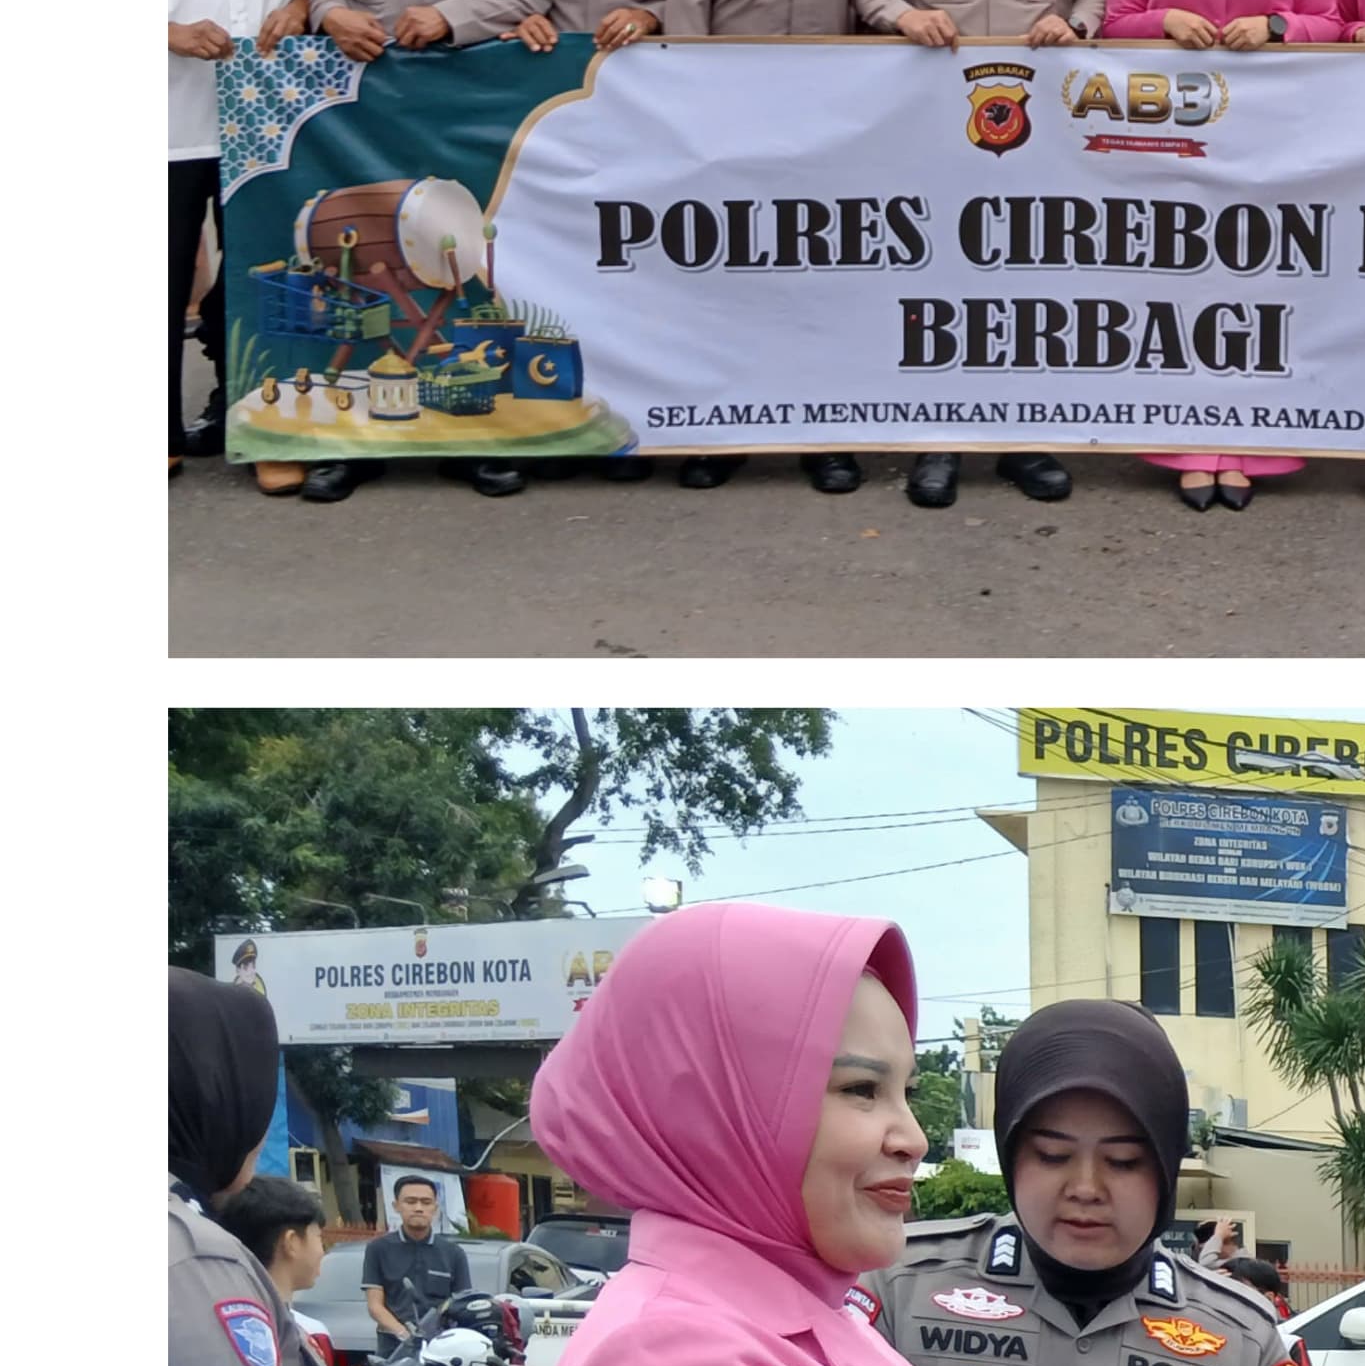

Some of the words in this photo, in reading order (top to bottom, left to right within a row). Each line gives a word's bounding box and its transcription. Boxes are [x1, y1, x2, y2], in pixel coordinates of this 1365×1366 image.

[969, 68, 995, 79] JAWA
[1072, 72, 1212, 126] AB3
[596, 196, 930, 272] POLRES
[957, 198, 1330, 275] CIREBON
[899, 297, 1290, 373] BERBAGI
[647, 405, 795, 427] SELAMAT
[802, 402, 1009, 423] MENUNAIKAN
[1016, 403, 1136, 424] IBADAH
[1142, 405, 1244, 427] PUASA
[1034, 719, 1208, 770] POLRES
[1151, 799, 1206, 818] POLRES
[1208, 803, 1270, 822] CIREBON
[1271, 809, 1309, 825] KOTA
[315, 964, 384, 988] POLRES
[391, 961, 478, 985] CIREBON
[483, 958, 531, 982] KOTA
[567, 950, 613, 987] AB
[345, 1002, 393, 1019] ZONA
[398, 999, 499, 1018] INTEGRITAS
[919, 1325, 1028, 1362] WIDYA
